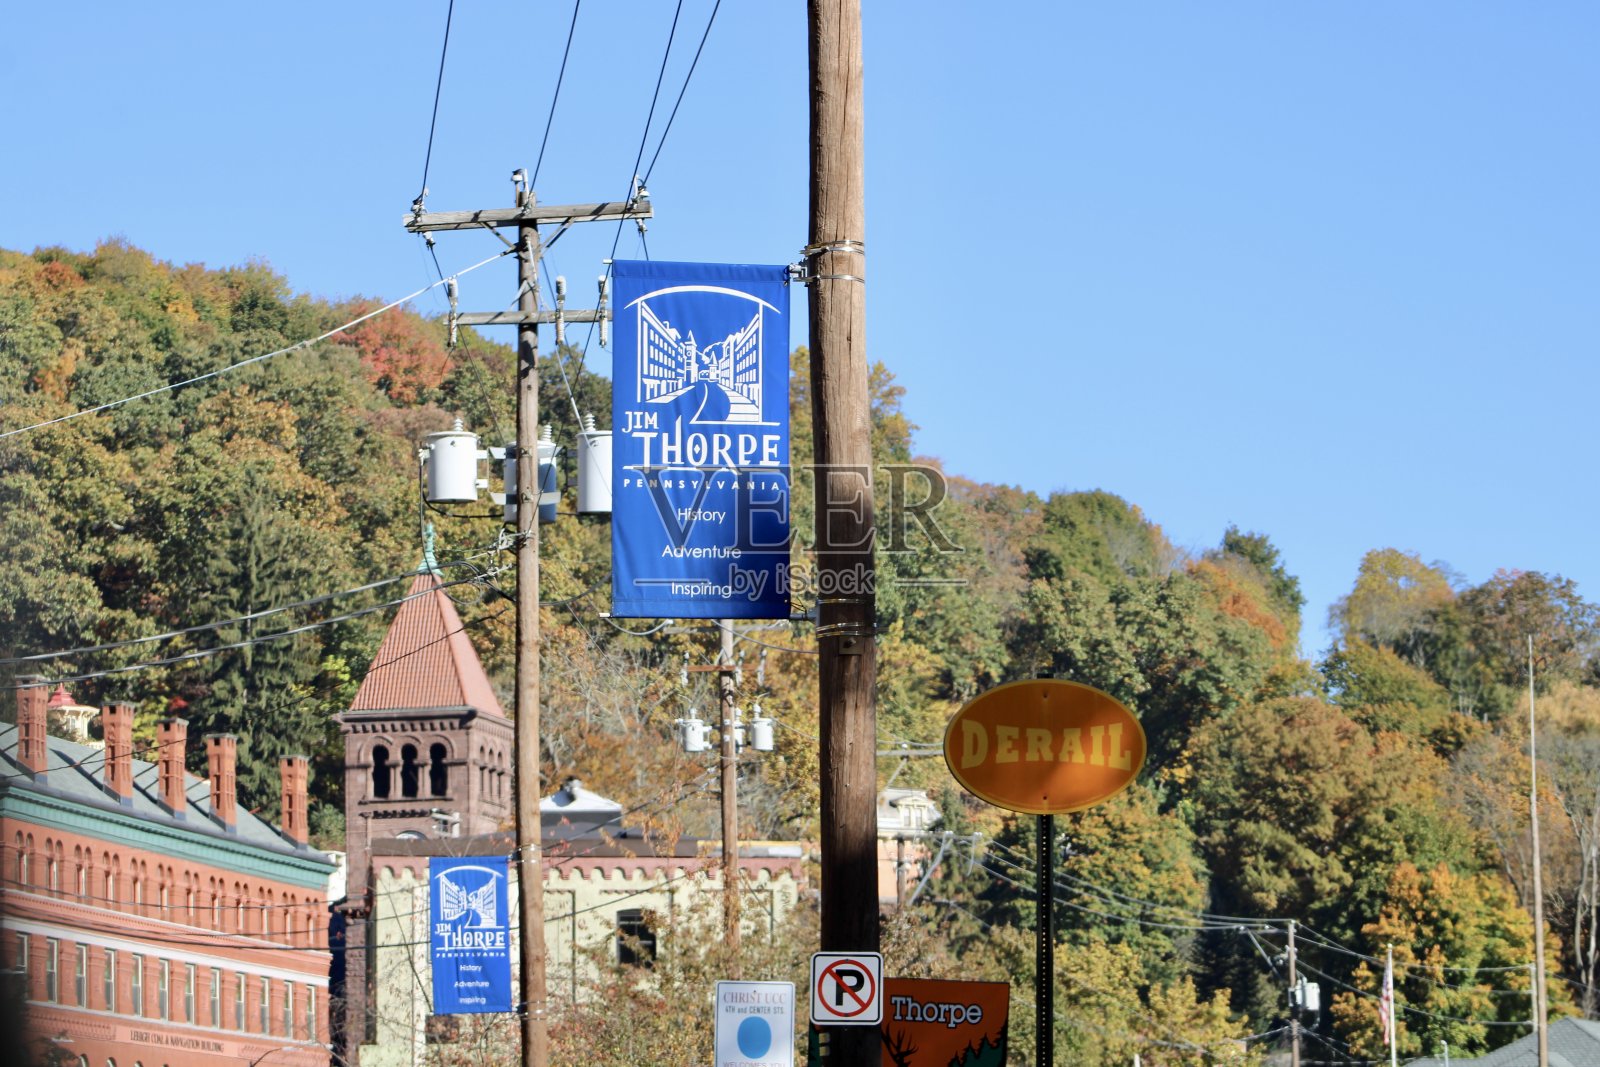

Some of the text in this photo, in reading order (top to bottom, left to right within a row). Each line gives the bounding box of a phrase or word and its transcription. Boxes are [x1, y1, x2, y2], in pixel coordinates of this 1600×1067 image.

[621, 411, 659, 433] JIM
[631, 415, 781, 475] THORPE
[623, 478, 780, 491] PENNSYLVANIA
[677, 508, 726, 524] History
[661, 545, 742, 559] Adventure
[671, 582, 732, 598] Inspiring
[961, 719, 1132, 771] DERAIL
[434, 923, 452, 935] JIM
[439, 924, 506, 951] THORPE
[459, 964, 482, 972] History
[835, 969, 865, 1006] P
[723, 992, 787, 1004] CHRIST UCC
[749, 1006, 771, 1015] CENTER
[891, 996, 983, 1028] Thorpe
